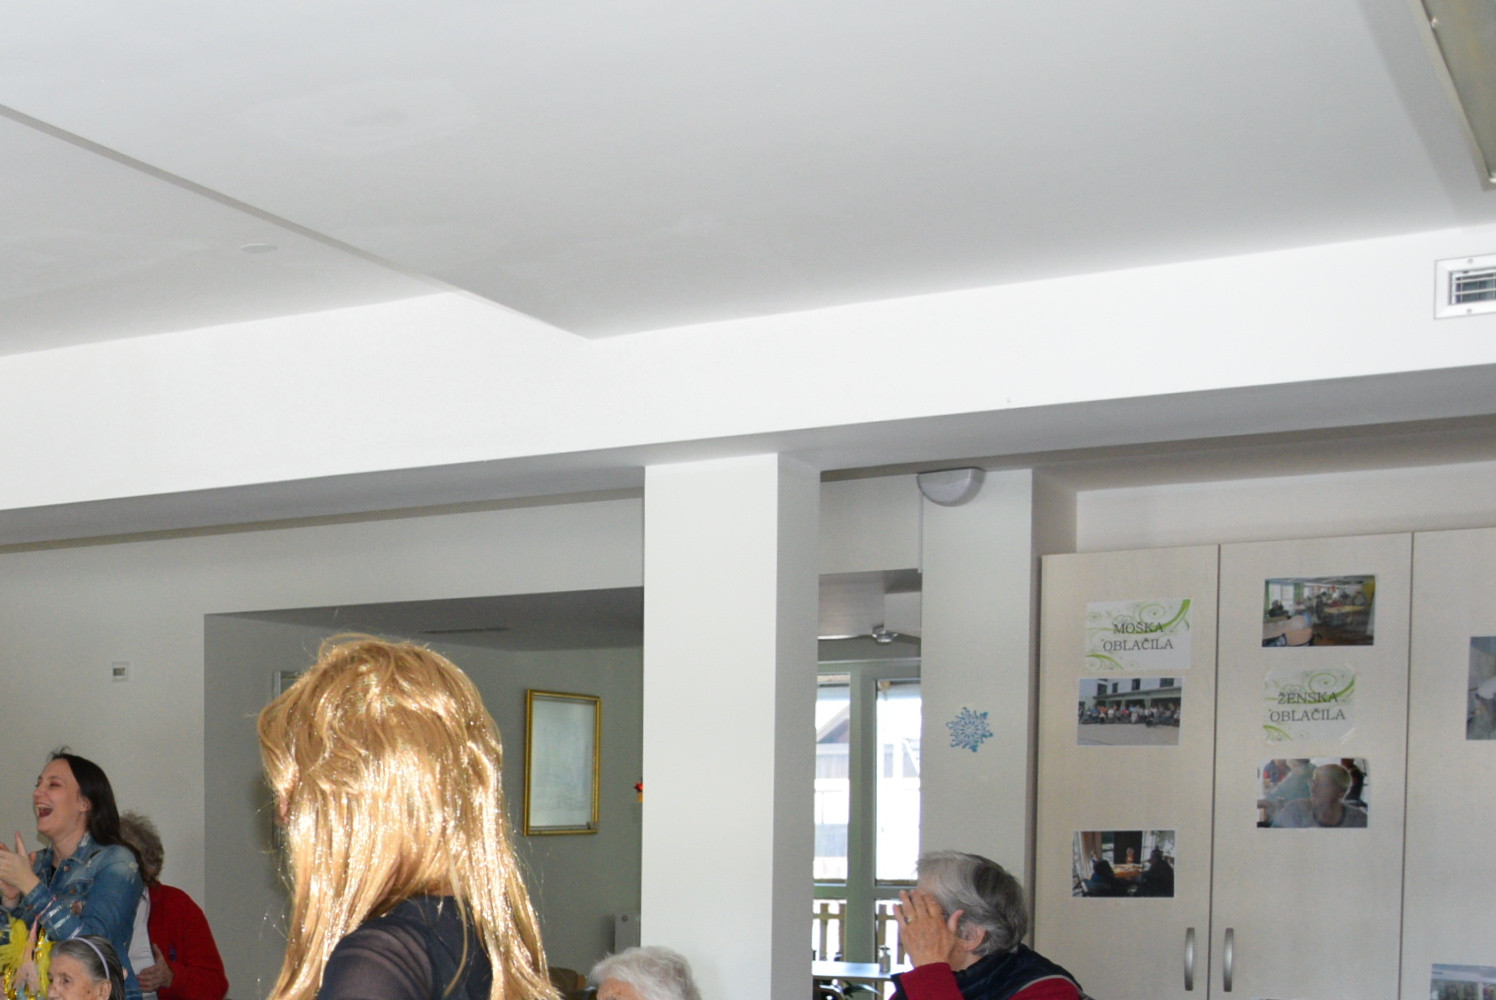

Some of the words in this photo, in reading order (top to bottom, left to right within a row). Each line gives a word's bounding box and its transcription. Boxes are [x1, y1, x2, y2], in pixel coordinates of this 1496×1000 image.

[1113, 620, 1165, 634] MOŠKA
[1102, 638, 1174, 652] OBLAČILA
[1277, 691, 1339, 705] ŽENSKA
[1269, 708, 1346, 722] OBLAČILA
